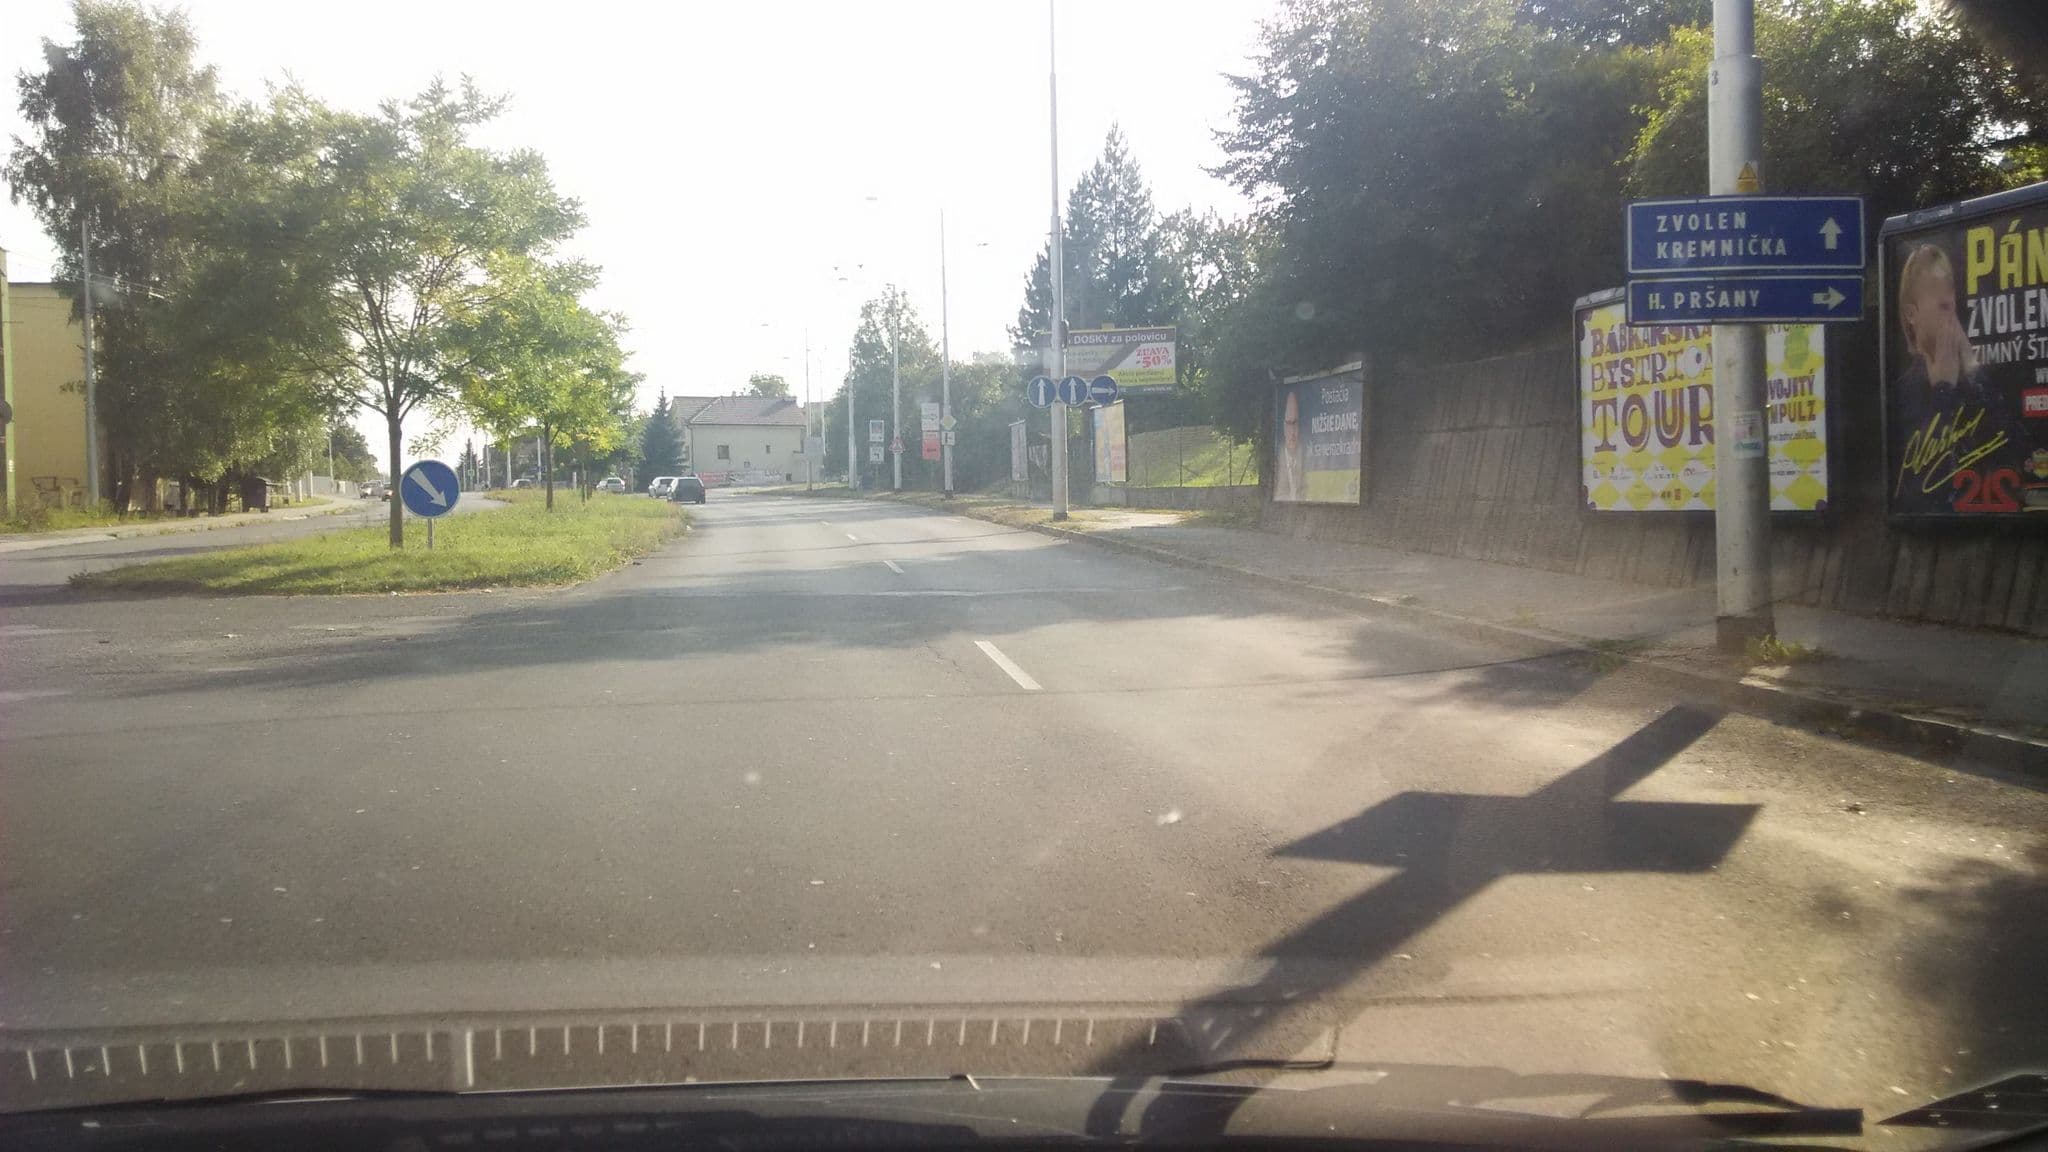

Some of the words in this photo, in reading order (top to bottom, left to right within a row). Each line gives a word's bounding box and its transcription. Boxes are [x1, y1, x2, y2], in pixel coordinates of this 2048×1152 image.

[1656, 212, 1746, 233] ZVOLEN
[1657, 234, 1787, 259] KREMNIČKA
[1649, 292, 1666, 310] H.
[1674, 285, 1760, 309] PRŠANY
[1073, 334, 1108, 345] DOSKY
[1125, 331, 1167, 344] polovicu
[1972, 336, 2023, 365] ZIMNÝ
[1768, 368, 1816, 400] VOJITÝ
[1592, 383, 1715, 454] TOUR
[1769, 400, 1816, 425] MPULZ
